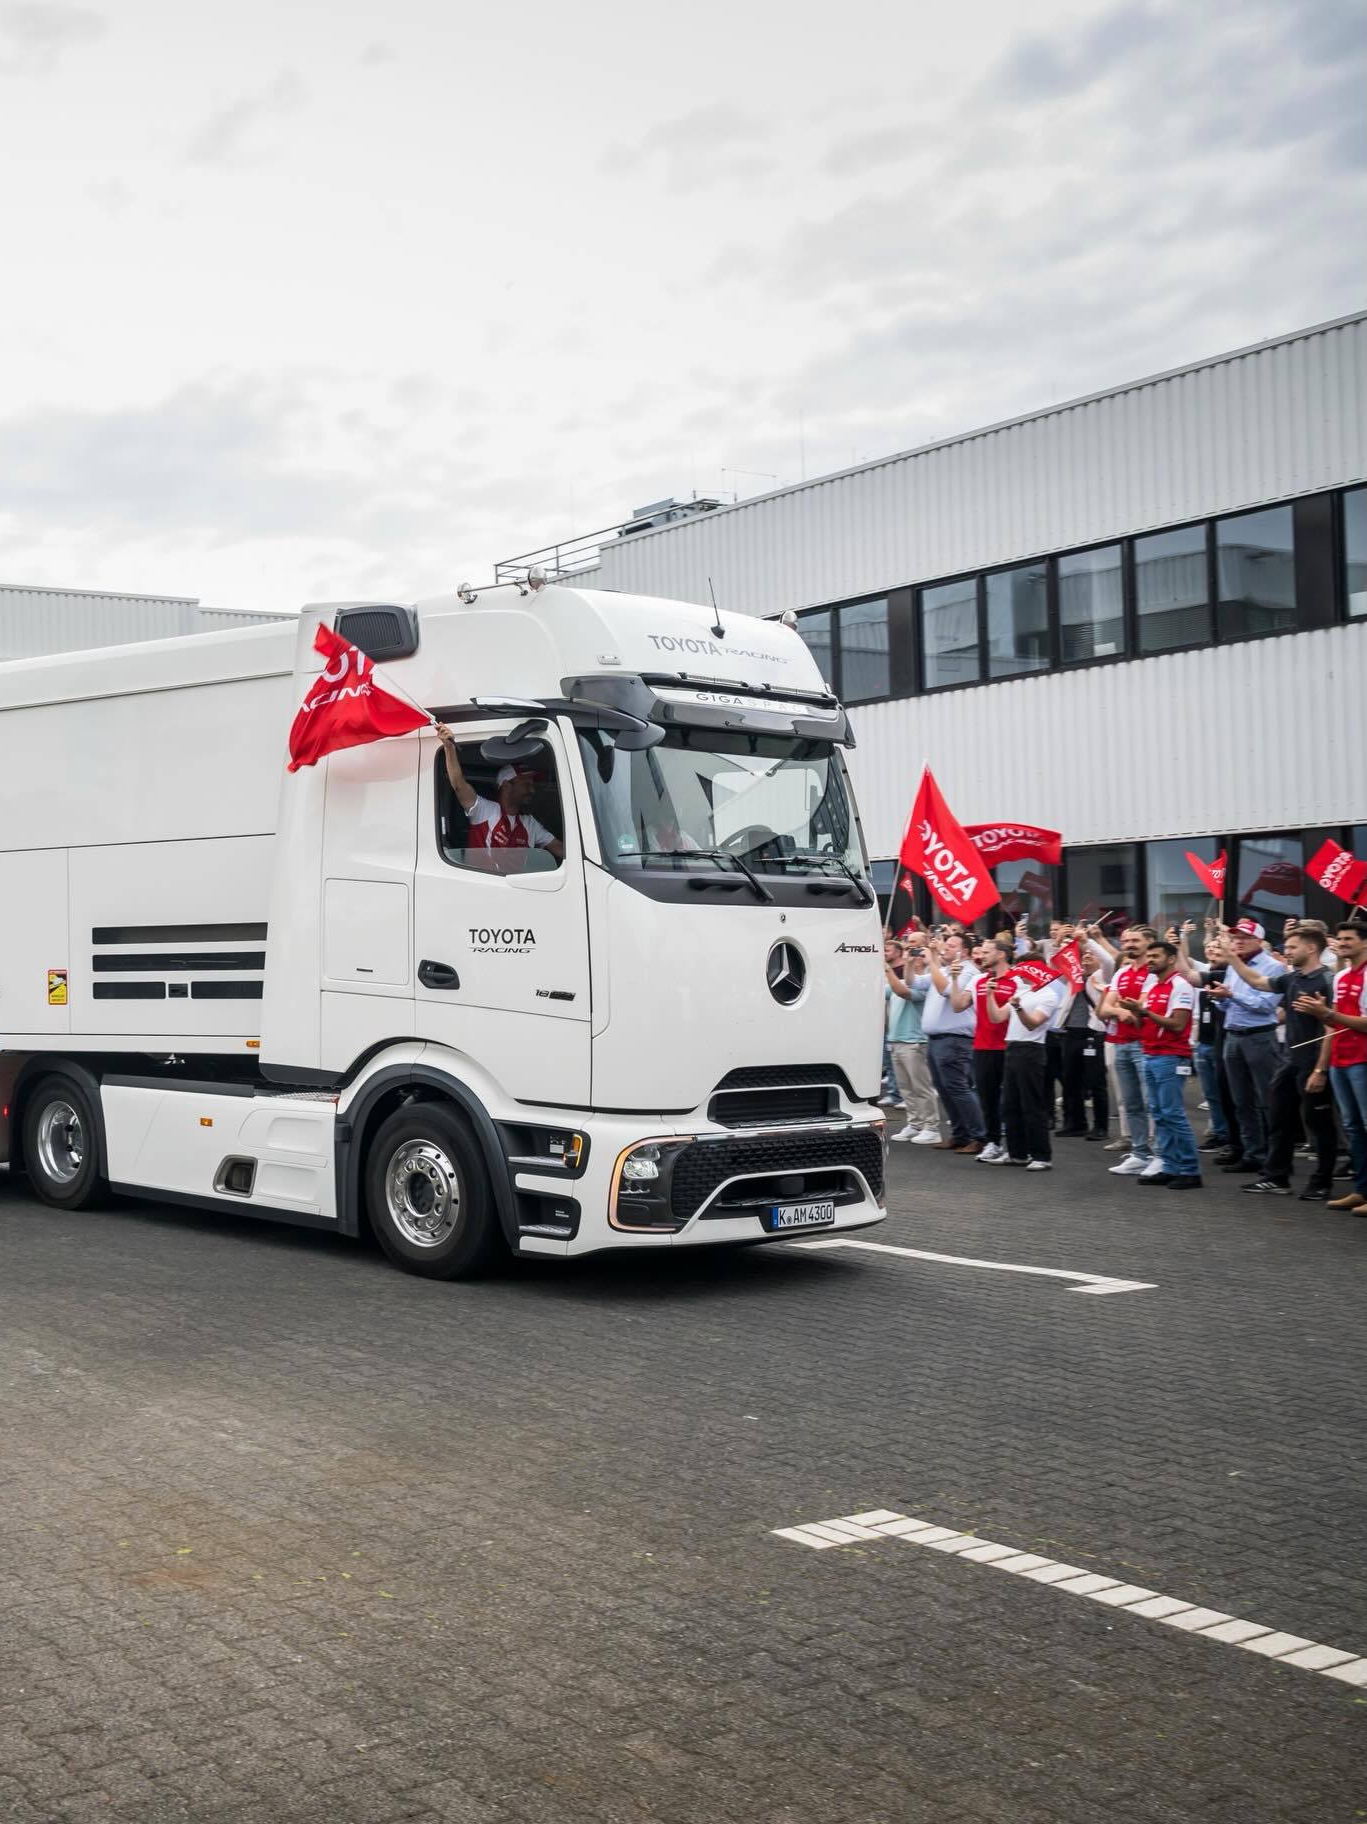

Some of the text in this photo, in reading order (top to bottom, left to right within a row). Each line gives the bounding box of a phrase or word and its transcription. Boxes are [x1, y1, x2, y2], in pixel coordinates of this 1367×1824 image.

[648, 635, 790, 664] TOYOTA RACING
[696, 693, 743, 705] GIGA
[468, 928, 537, 944] TOYOTA
[794, 1207, 807, 1224] AM
[808, 1204, 833, 1222] 4300
